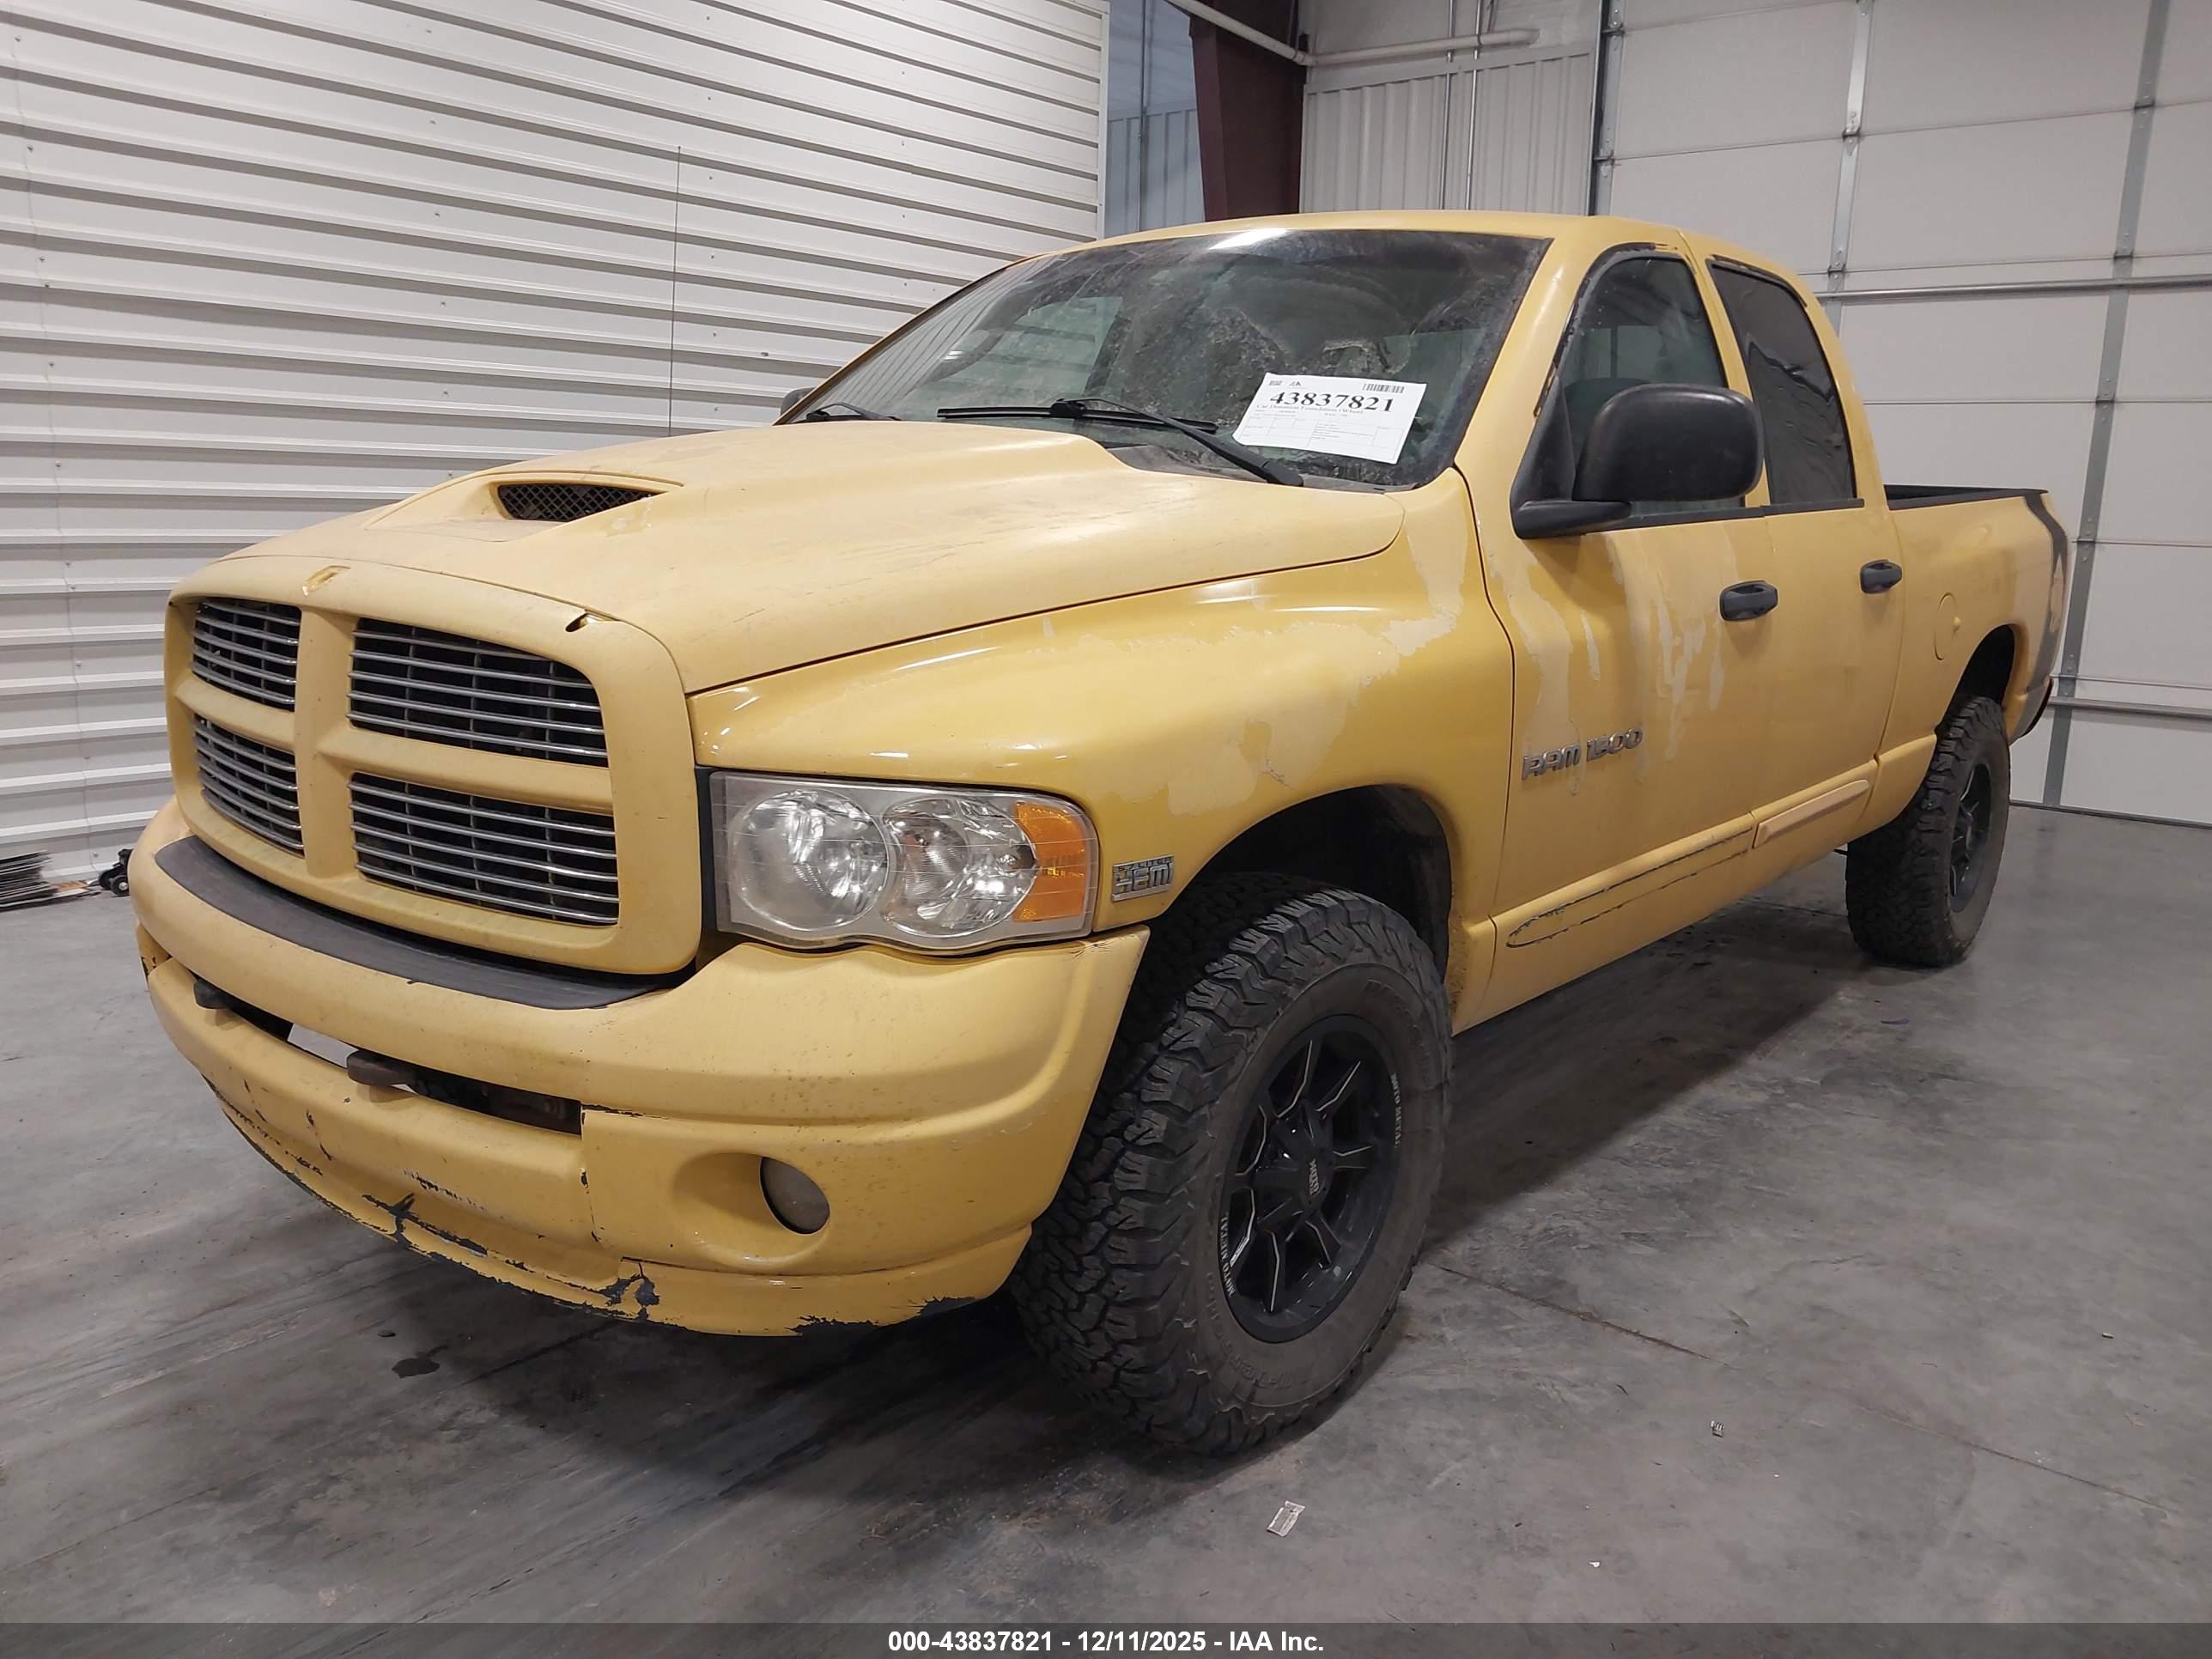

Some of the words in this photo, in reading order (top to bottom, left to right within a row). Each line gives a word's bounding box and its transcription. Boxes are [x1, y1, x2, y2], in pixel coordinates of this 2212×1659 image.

[1270, 392, 1395, 412] 43837821
[1522, 743, 1581, 781] RAM
[1587, 727, 1644, 762] 1500
[1113, 862, 1174, 893] HEMI
